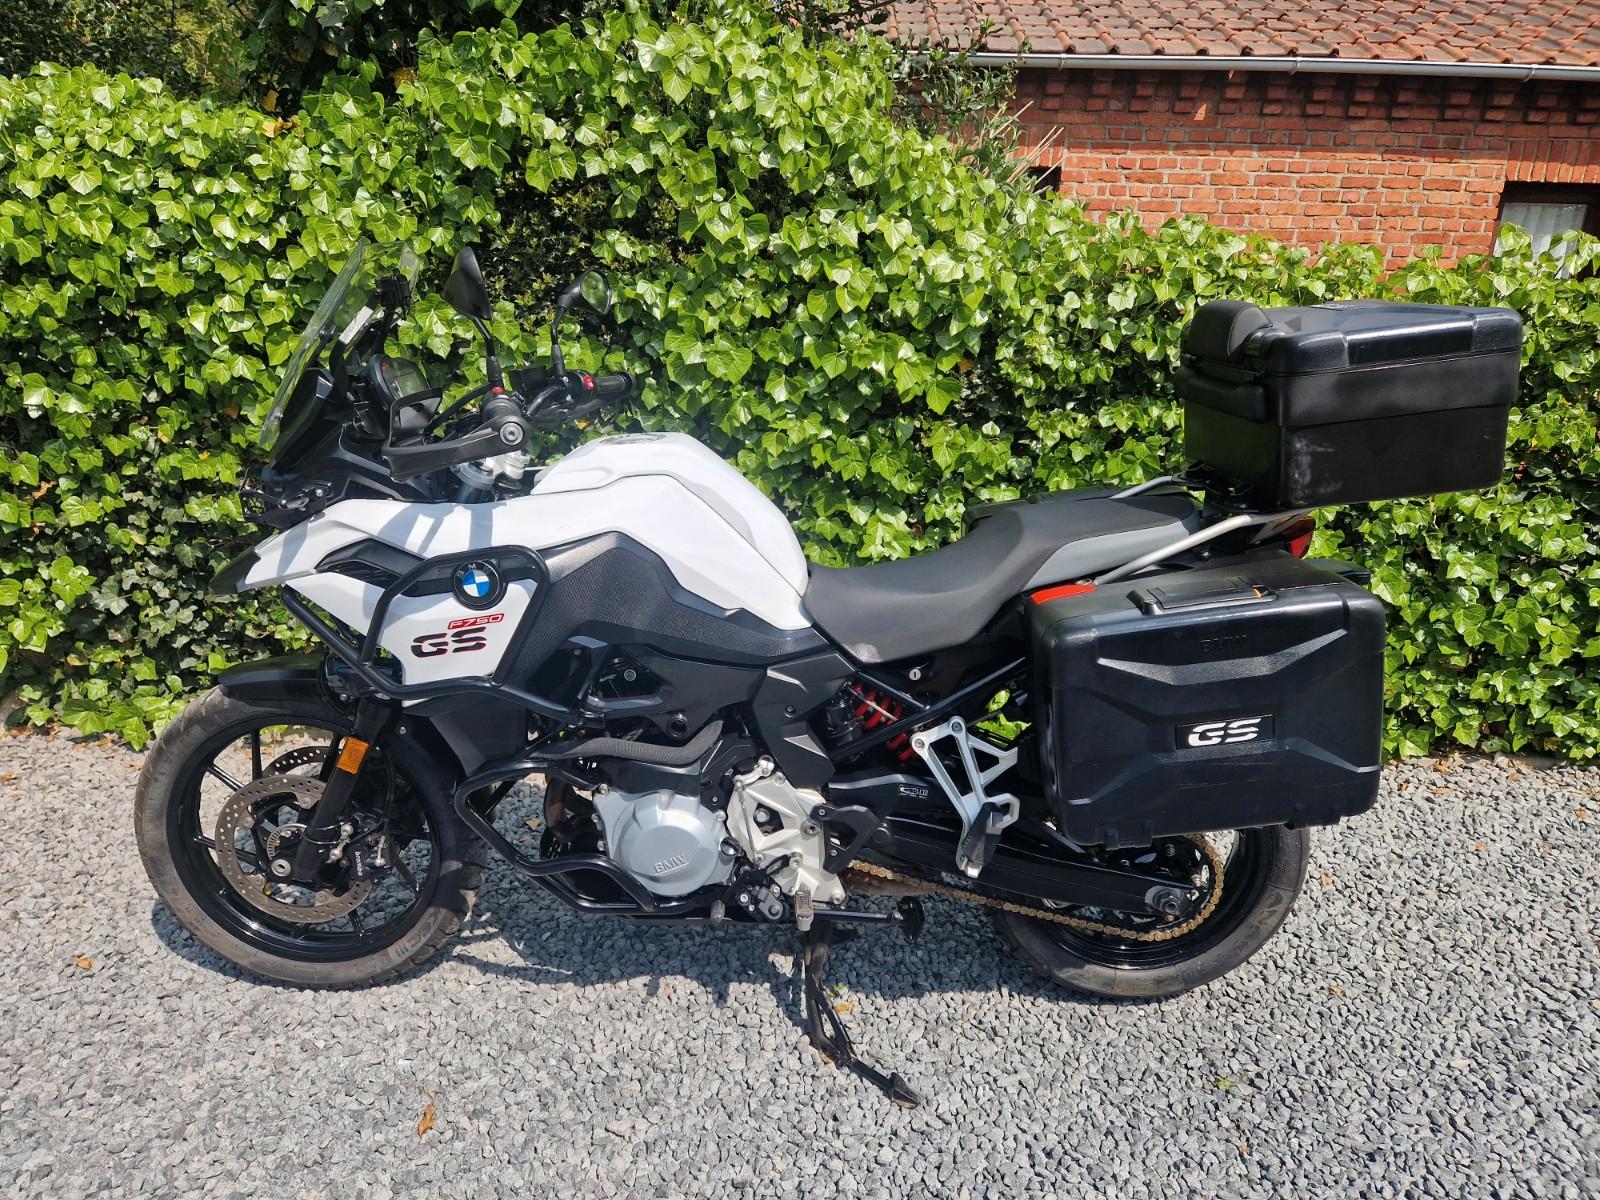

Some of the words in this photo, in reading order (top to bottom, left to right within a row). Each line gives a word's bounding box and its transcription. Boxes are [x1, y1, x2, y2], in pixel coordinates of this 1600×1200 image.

[449, 614, 504, 629] F750
[410, 626, 488, 658] GS
[1188, 718, 1262, 747] GS
[653, 852, 687, 873] BMW
